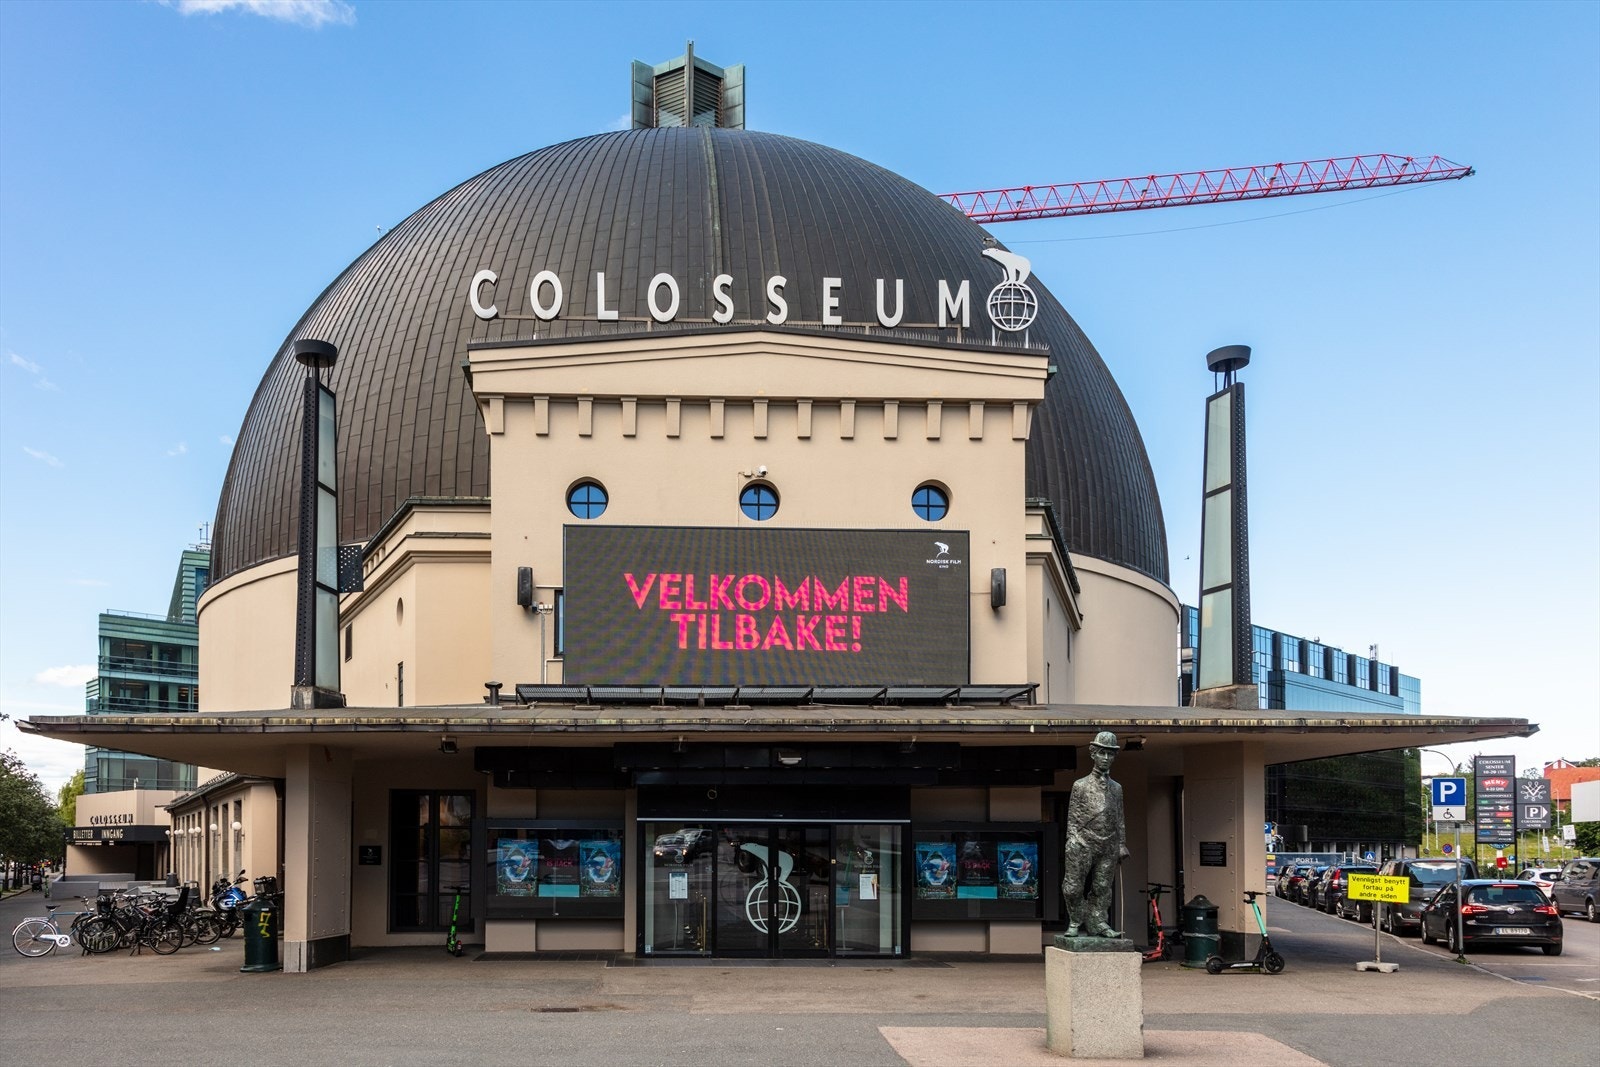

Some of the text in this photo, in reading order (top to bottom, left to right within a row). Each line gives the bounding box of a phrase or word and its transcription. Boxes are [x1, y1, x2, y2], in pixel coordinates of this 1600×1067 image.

[469, 269, 970, 329] COLOSSEUM
[624, 573, 908, 613] VELKOMMEN
[670, 613, 862, 653] TILBAKE!
[1440, 781, 1457, 803] P
[90, 814, 133, 824] COLOSSEUM
[1530, 808, 1538, 817] P
[74, 829, 124, 838] BILLETTER INNGANG
